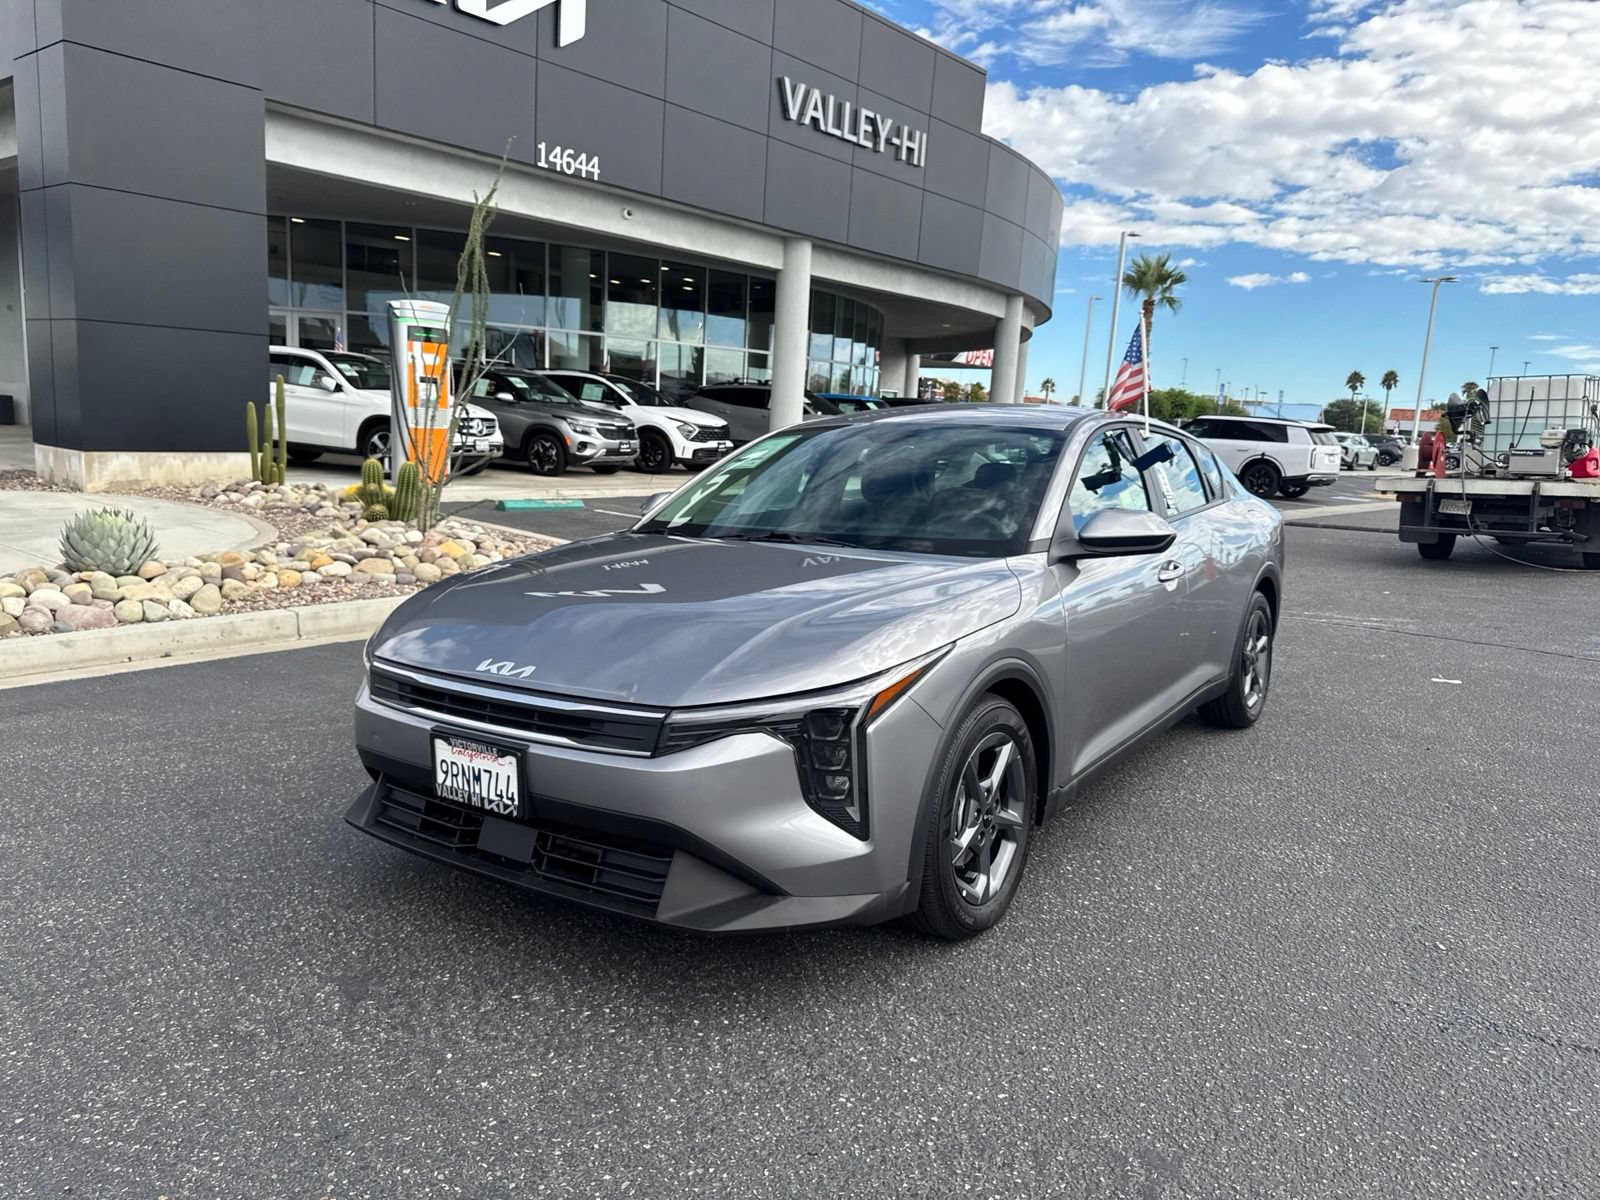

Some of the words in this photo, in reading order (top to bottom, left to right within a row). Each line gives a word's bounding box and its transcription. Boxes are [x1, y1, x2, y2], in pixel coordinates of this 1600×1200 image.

[779, 75, 927, 168] VALLEY-HI
[537, 141, 601, 181] 14644
[475, 658, 537, 679] KIA
[449, 737, 498, 756] VICTORVILLE
[435, 782, 469, 803] VALLEY
[471, 791, 482, 808] HI
[440, 758, 516, 805] 9RNM744
